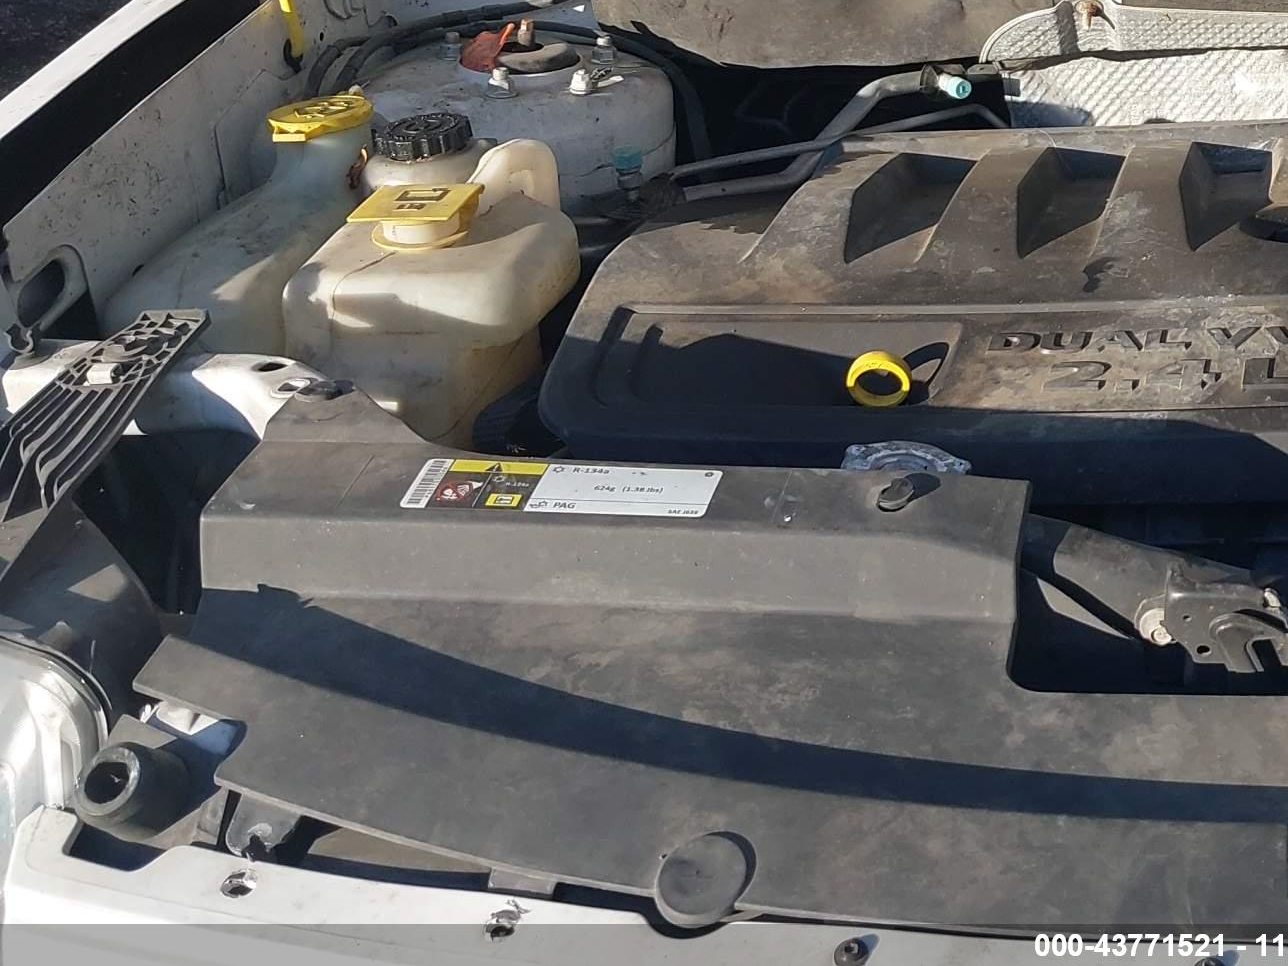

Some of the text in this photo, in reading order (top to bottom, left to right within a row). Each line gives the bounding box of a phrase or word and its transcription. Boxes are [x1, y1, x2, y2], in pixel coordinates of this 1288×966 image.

[987, 328, 1193, 353] DUAL
[572, 467, 610, 475] R-134a
[593, 485, 616, 493] 624g
[552, 501, 576, 509] PAG
